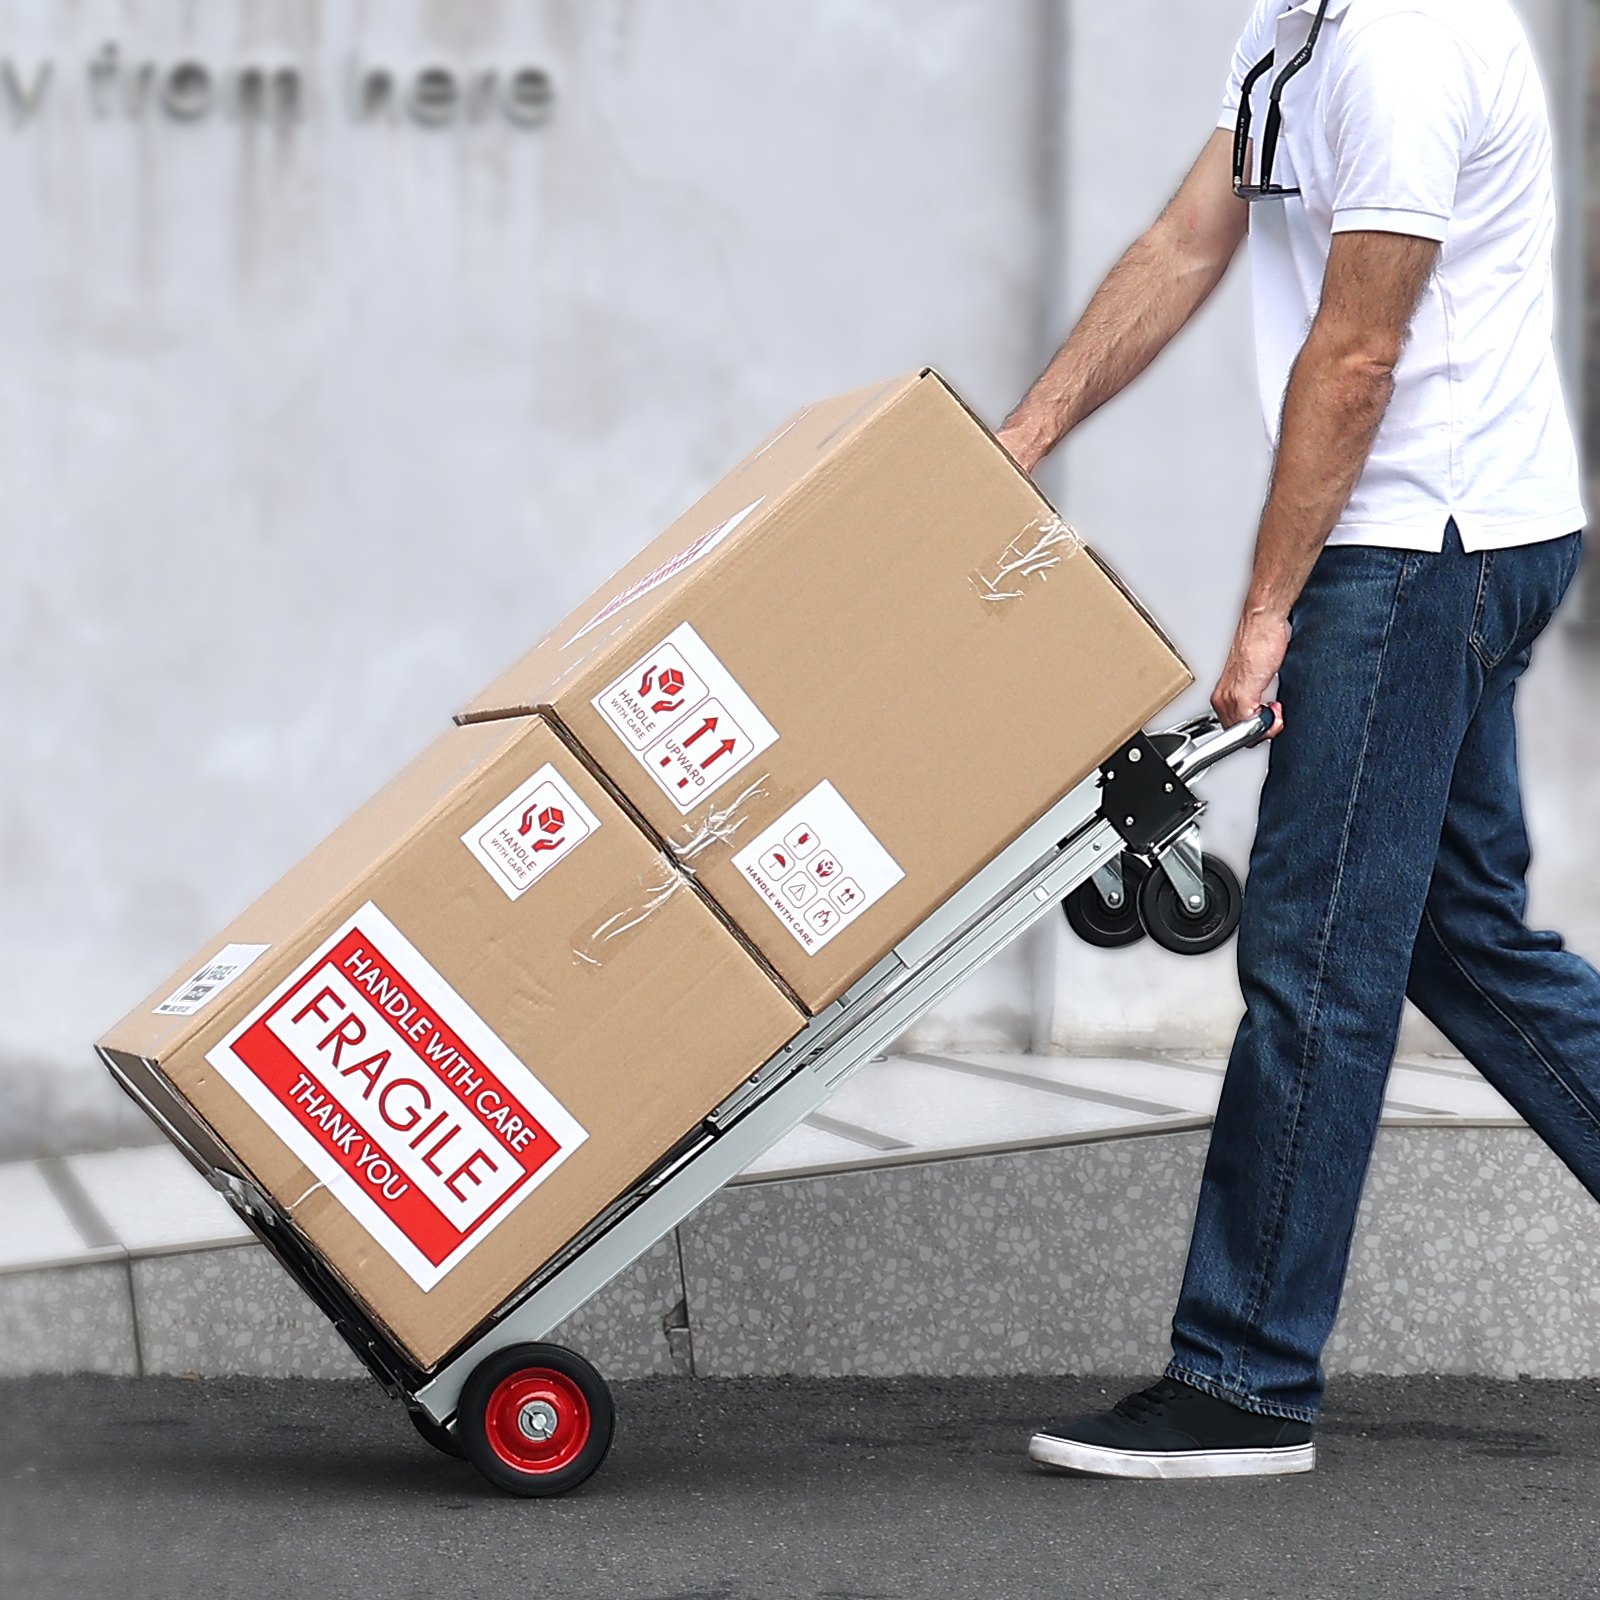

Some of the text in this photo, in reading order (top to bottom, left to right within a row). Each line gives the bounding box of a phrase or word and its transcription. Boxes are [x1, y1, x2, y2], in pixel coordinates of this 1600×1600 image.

[611, 698, 646, 740] WITH CARE
[619, 689, 656, 732] HANDLE
[665, 739, 706, 786] UPWARD
[490, 838, 527, 879] WITH CARE
[499, 829, 537, 871] HANDLE
[745, 865, 814, 946] HANDLE WITH CARE
[344, 948, 537, 1153] HANDLE WITH CARE
[291, 985, 499, 1203] FRAGILE
[287, 1073, 409, 1200] THANK YOU
